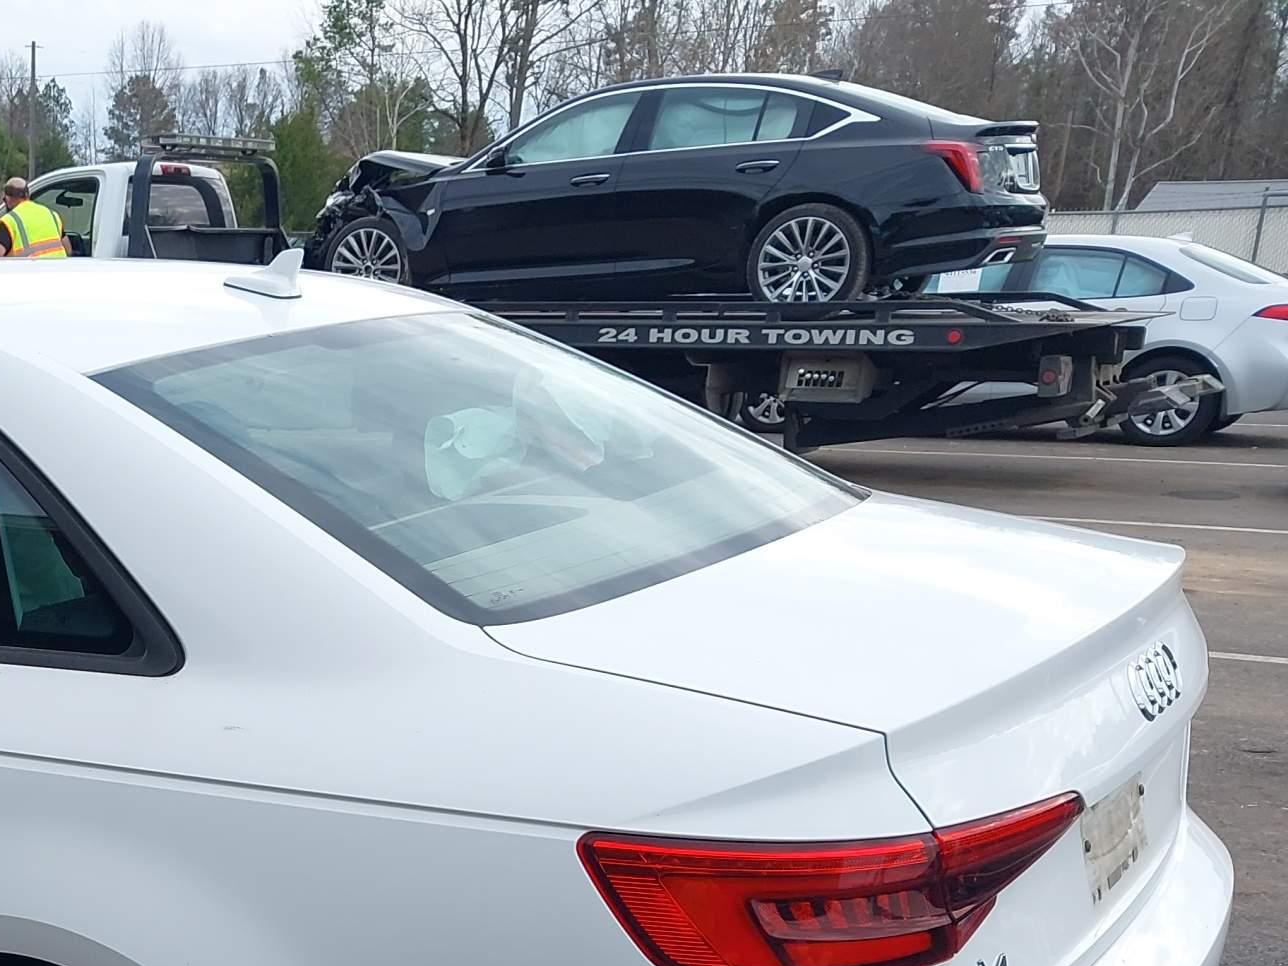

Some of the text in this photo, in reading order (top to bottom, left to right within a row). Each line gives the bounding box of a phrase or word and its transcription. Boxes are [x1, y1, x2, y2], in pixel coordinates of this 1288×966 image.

[597, 327, 915, 346] 24 HOUR TOWING
